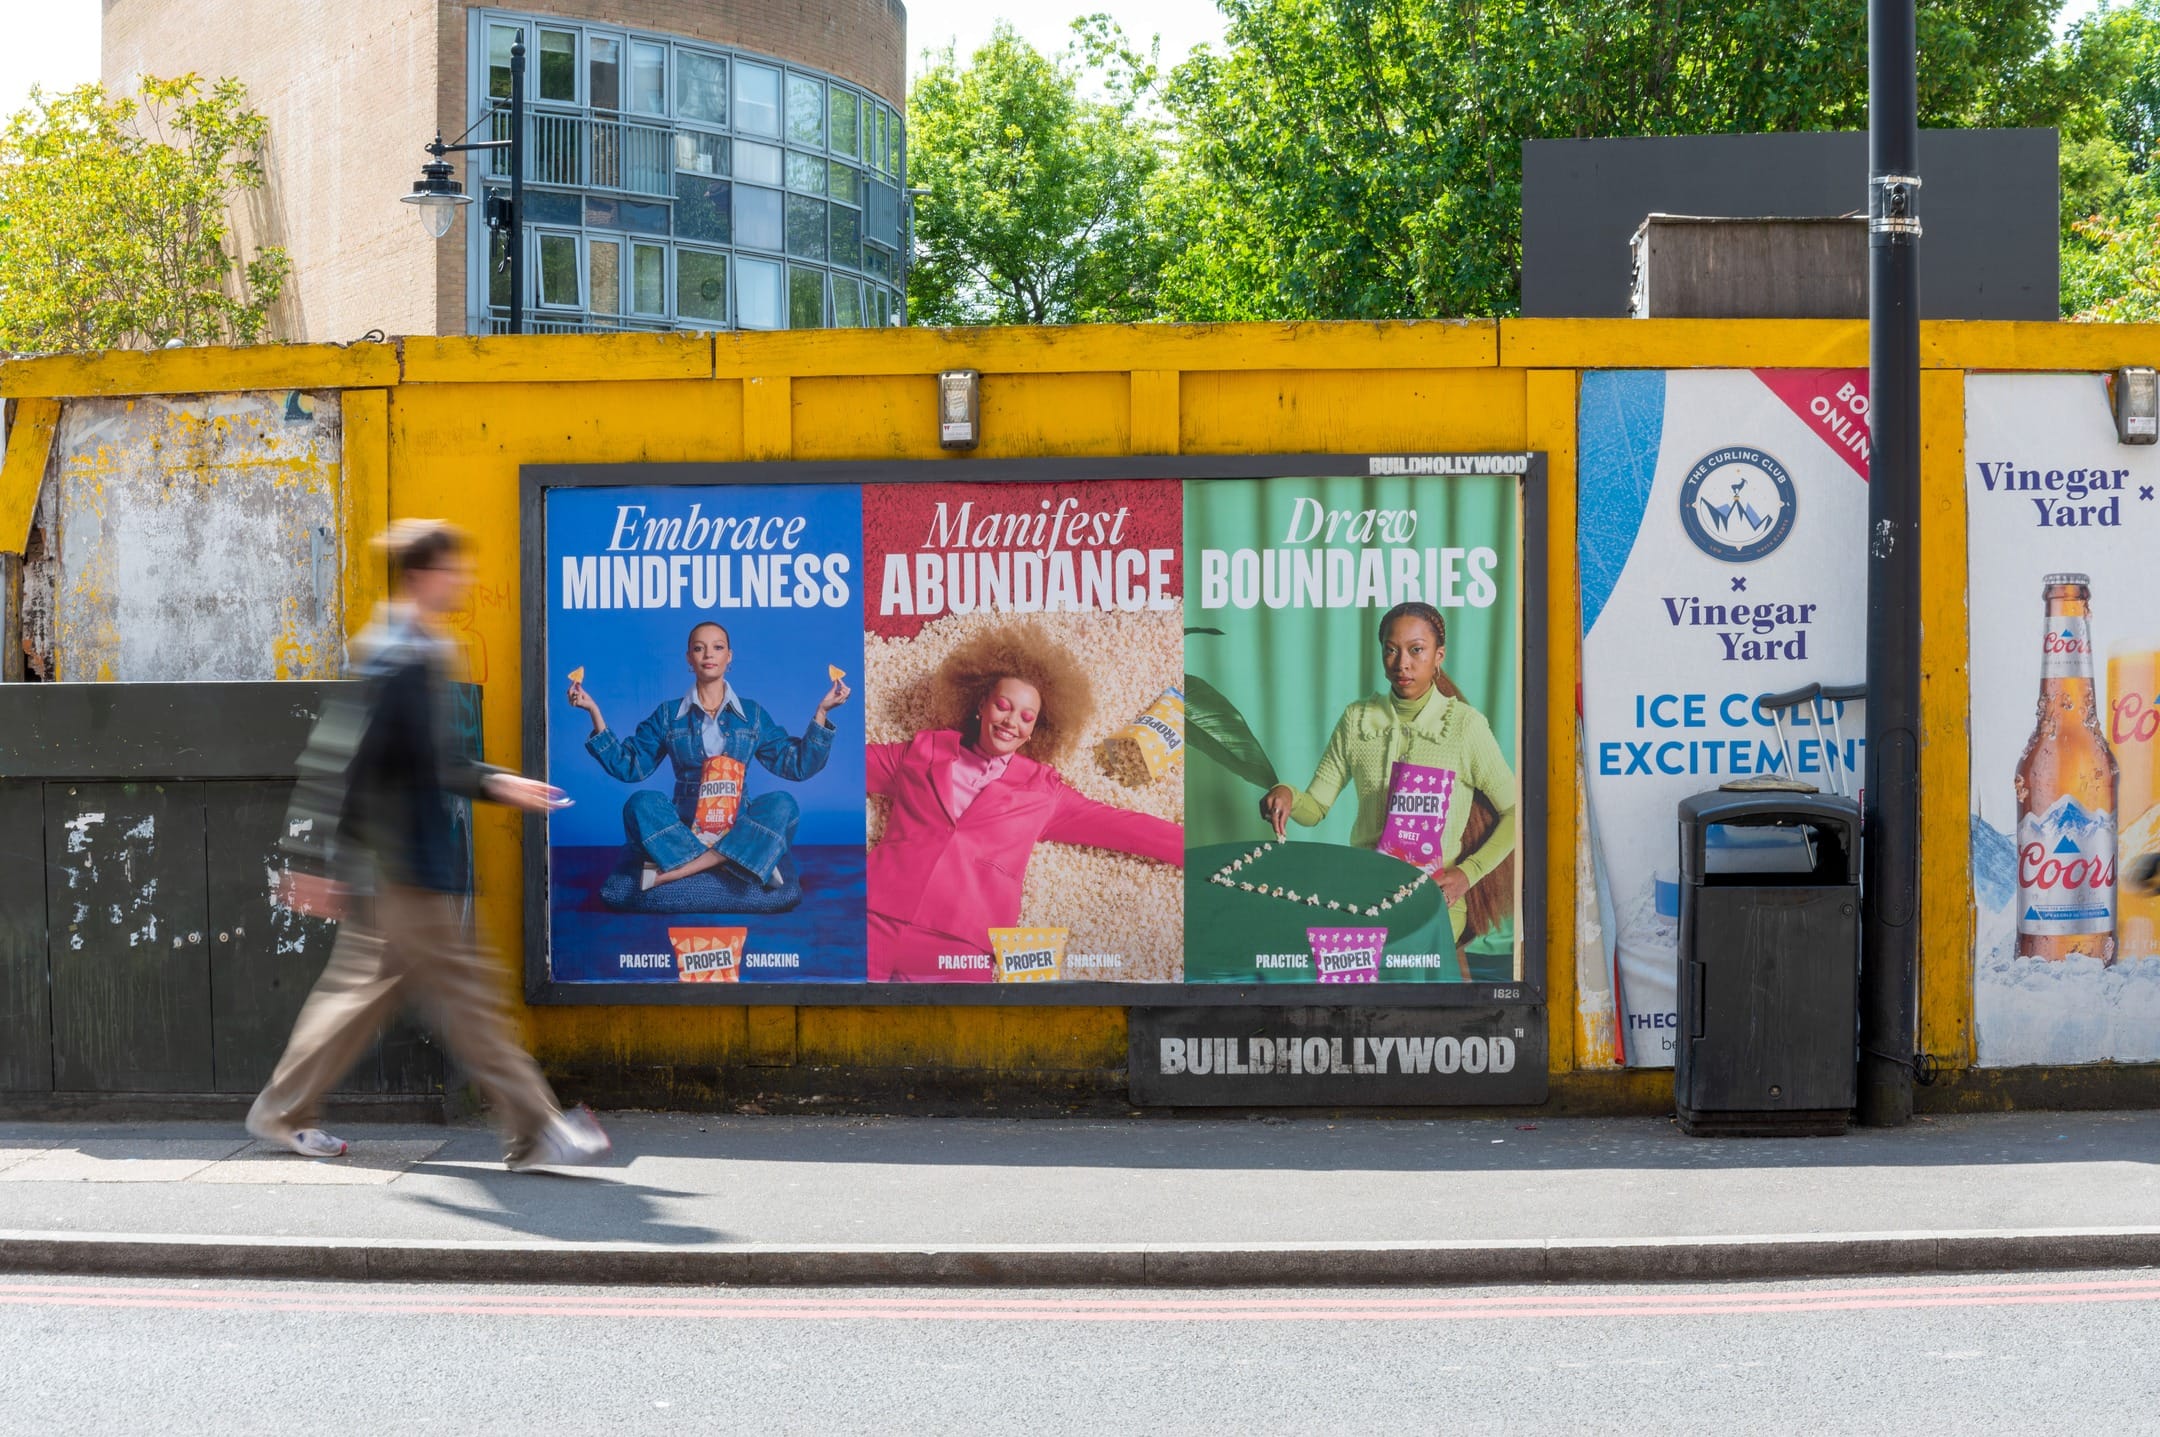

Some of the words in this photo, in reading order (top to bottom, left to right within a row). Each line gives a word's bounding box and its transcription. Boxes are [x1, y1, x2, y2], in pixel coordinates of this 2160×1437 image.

[1836, 381, 1870, 427] BO
[1810, 396, 1870, 466] ONLIN
[1369, 456, 1528, 475] BUILDHOLLYWOOD
[1688, 464, 1708, 485] THE
[1708, 451, 1759, 466] CURLING
[1761, 459, 1787, 484] CLUB
[1976, 461, 2130, 500] Vinegar
[606, 503, 806, 551] Embrace
[921, 497, 1131, 559] Manifest
[1282, 497, 1418, 544] Draw
[2031, 496, 2122, 527] Yard
[562, 553, 850, 609] MINDFULNESS
[880, 548, 1174, 616] ABUNDANCE
[1201, 546, 1498, 609] BOUNDARIES
[1661, 597, 1817, 635] Vinegar
[1716, 630, 1808, 661] Yard
[1636, 693, 1706, 728] ICE
[1719, 691, 1844, 728] COLD
[1600, 738, 1867, 776] EXCITEMEN
[701, 782, 737, 797] PROPER
[1390, 795, 1440, 813] PROPER
[1398, 830, 1420, 842] SWEET
[2018, 841, 2117, 890] Coors
[619, 954, 671, 968] PRACTICE
[684, 950, 733, 971] PROPER
[746, 953, 800, 968] SNACKING
[938, 955, 990, 969] PRACTICE
[1005, 951, 1053, 972] PROPER
[1067, 954, 1122, 969] SNACKING
[1256, 954, 1309, 968] PRACTICE
[1323, 951, 1372, 971] PROPER
[1385, 954, 1441, 968] SNACKING
[1493, 988, 1520, 999] 1826
[1628, 1012, 1677, 1029] THEC
[1160, 1036, 1516, 1075] BUILDHOLLYWOOD
